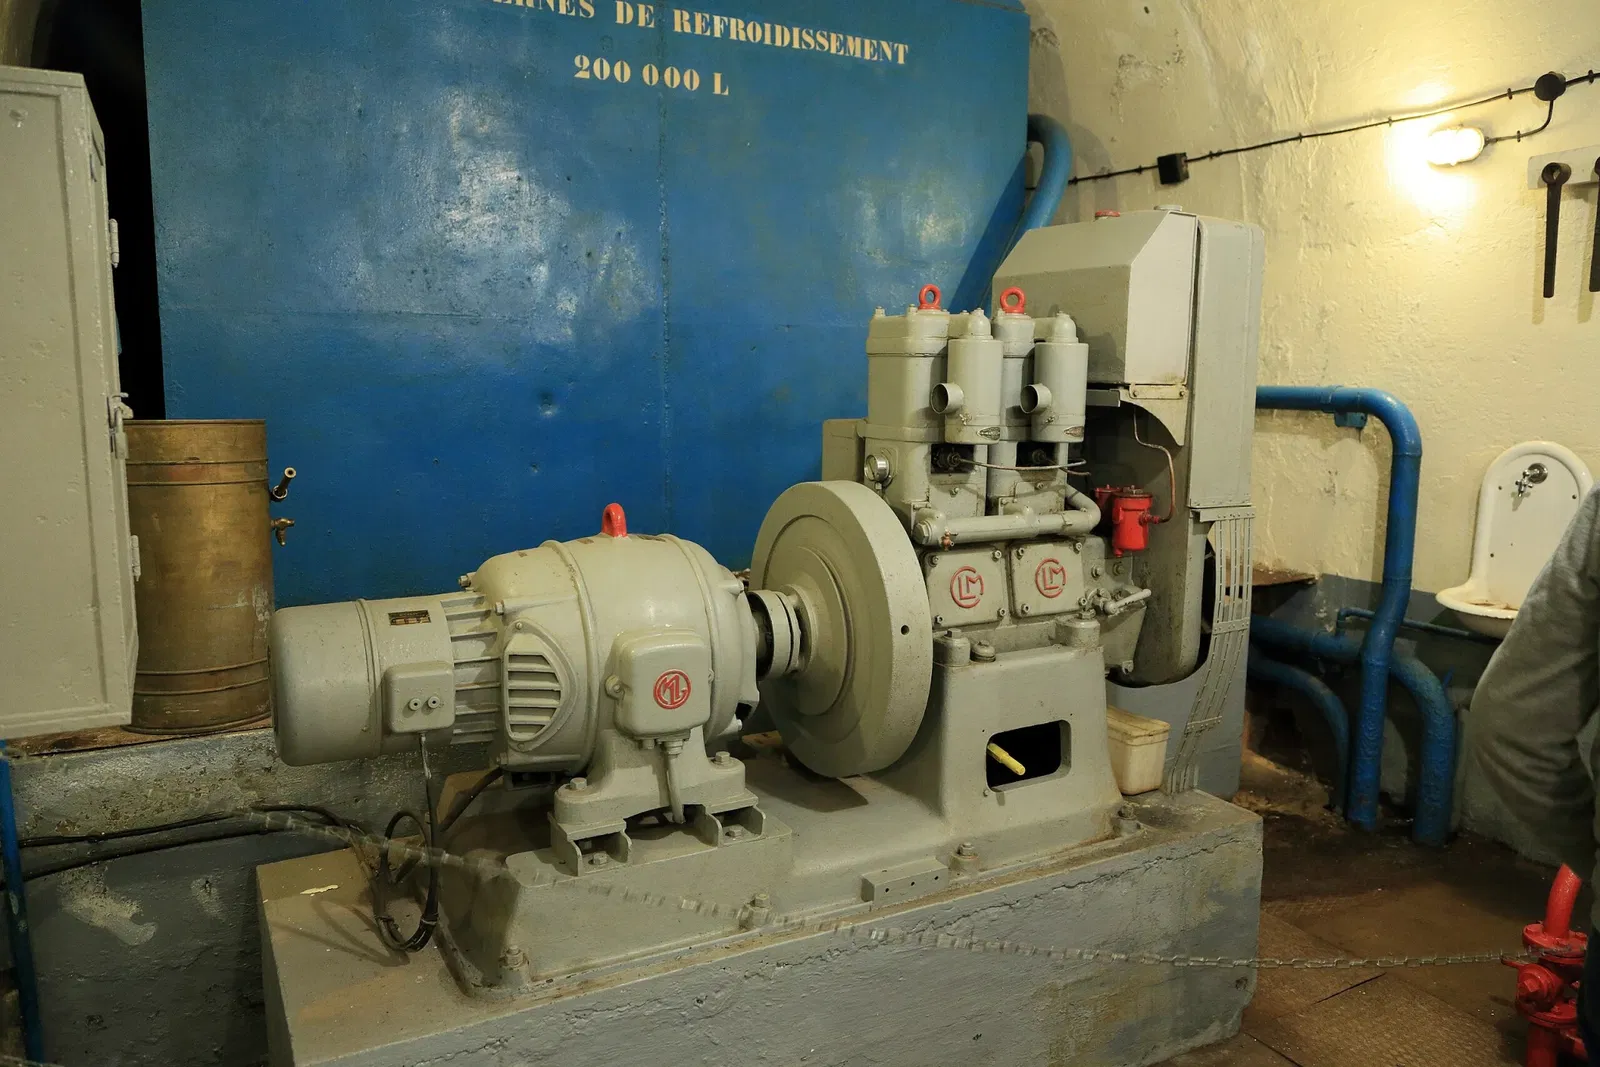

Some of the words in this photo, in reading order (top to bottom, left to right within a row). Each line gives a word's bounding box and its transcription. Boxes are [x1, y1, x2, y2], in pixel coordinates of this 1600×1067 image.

[615, 0, 655, 28] DE
[673, 9, 908, 64] REFROIDISSEMENT
[574, 54, 631, 83] 200
[642, 63, 700, 91] 000
[713, 72, 729, 95] L
